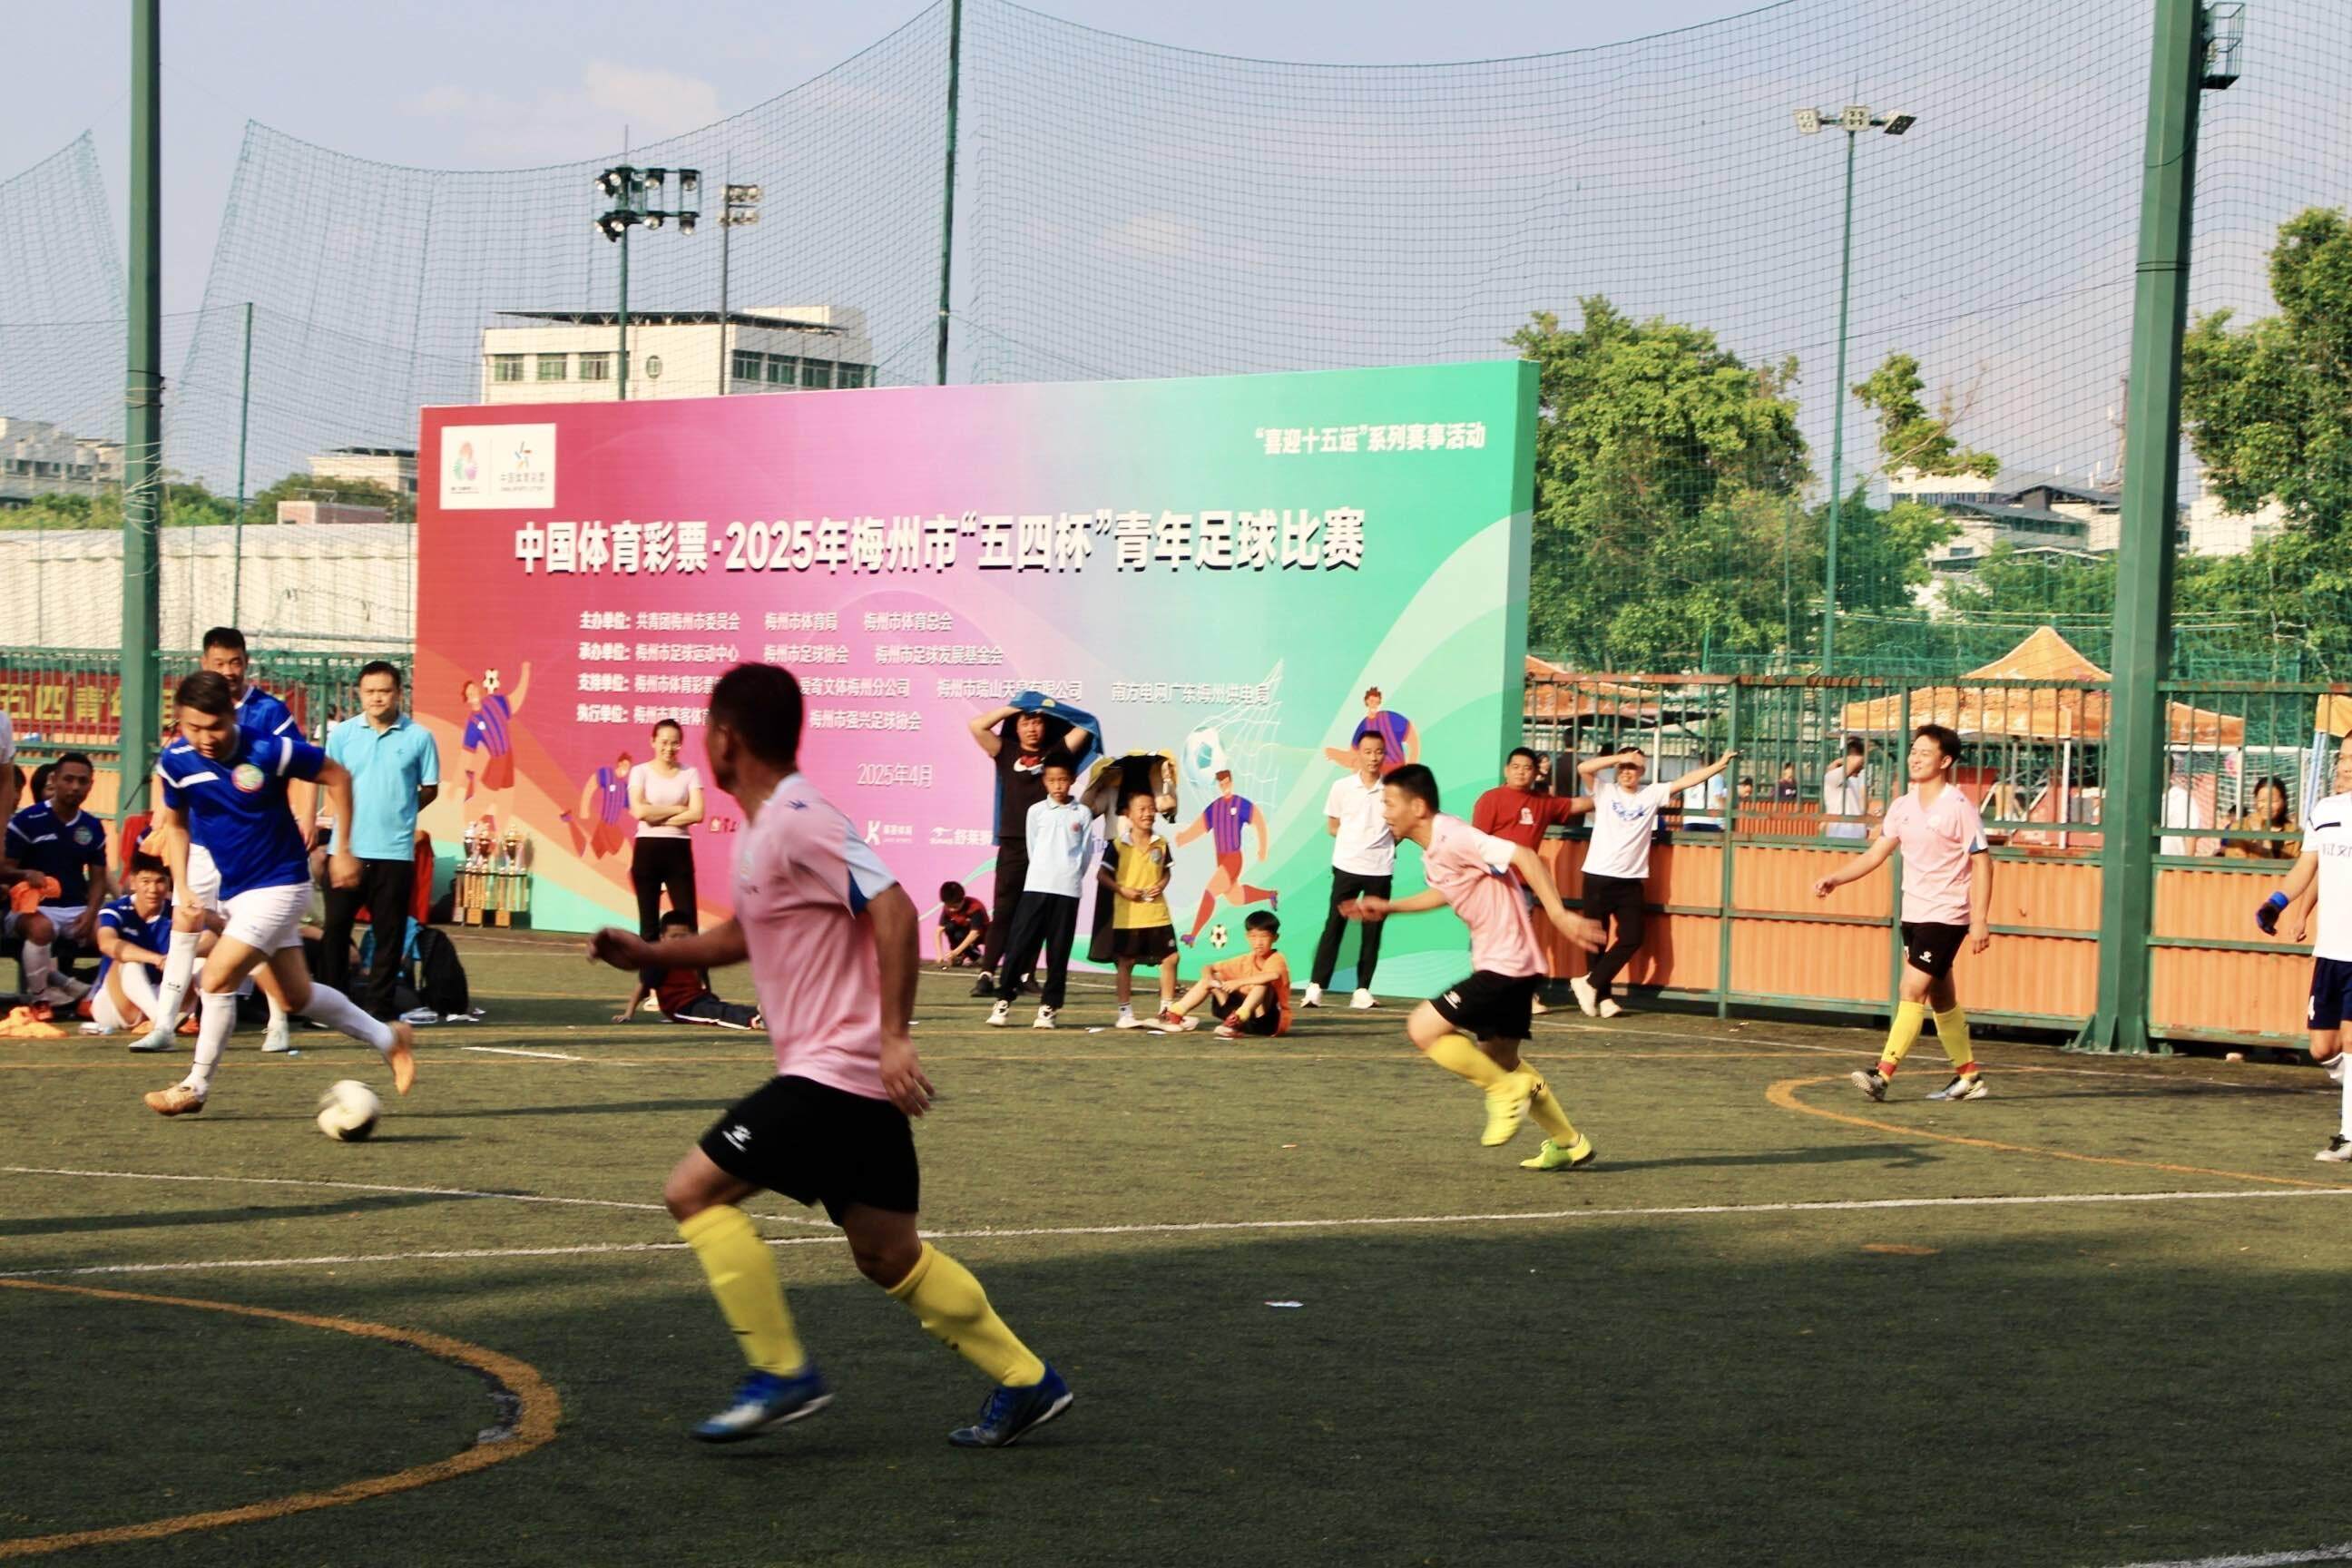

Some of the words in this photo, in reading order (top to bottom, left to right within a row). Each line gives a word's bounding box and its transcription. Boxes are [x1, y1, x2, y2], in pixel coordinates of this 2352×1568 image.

[1254, 422, 1486, 455] “喜迎十五运”系列赛事活动
[635, 612, 741, 632] 共青团梅州市委员会
[763, 612, 838, 632] 梅州市体育局
[863, 612, 954, 632] 梅州市体育总会
[634, 642, 740, 662] 梅州市足球运动中心
[763, 644, 849, 664] 梅州市足球协会
[874, 645, 1004, 666] 梅州市足球发展基金会
[634, 674, 722, 695] 梅州市体育彩票
[1110, 681, 1271, 705] 南方电网广东梅州供电局
[856, 762, 934, 789] 2025年4月
